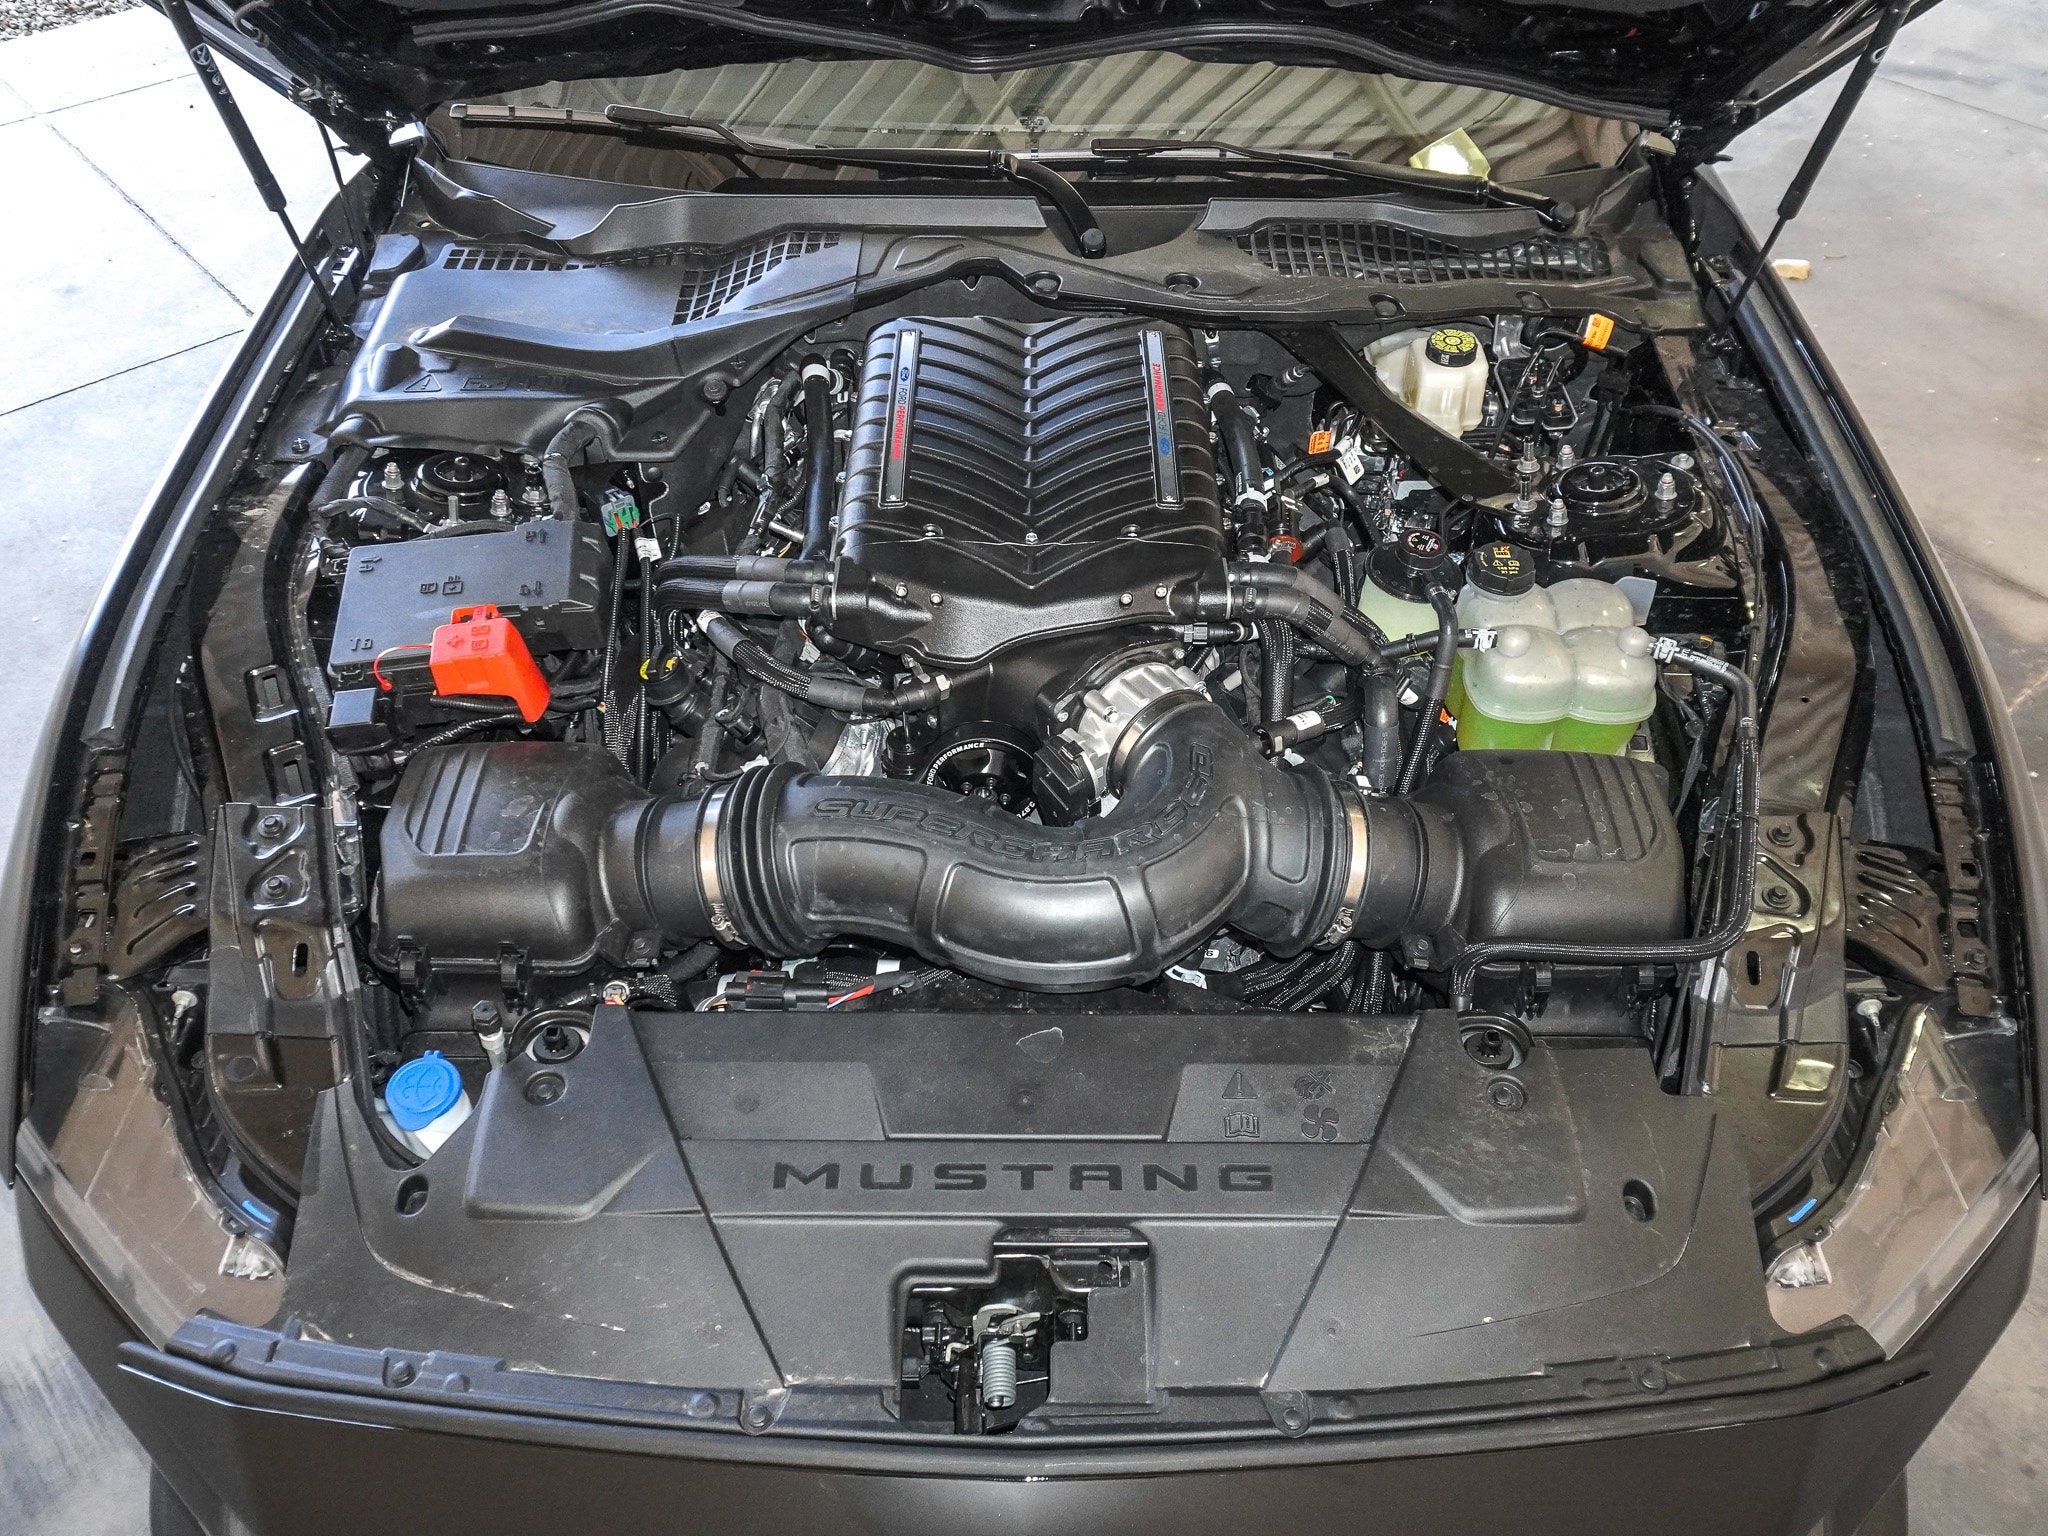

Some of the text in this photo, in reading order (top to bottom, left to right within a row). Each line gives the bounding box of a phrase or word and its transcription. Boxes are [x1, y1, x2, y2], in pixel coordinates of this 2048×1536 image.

[897, 387, 908, 405] FORD
[926, 743, 985, 786] FORD PERFORMANCE
[813, 741, 1214, 863] SUPERCHARGED
[772, 1161, 1275, 1192] MUSTANG
